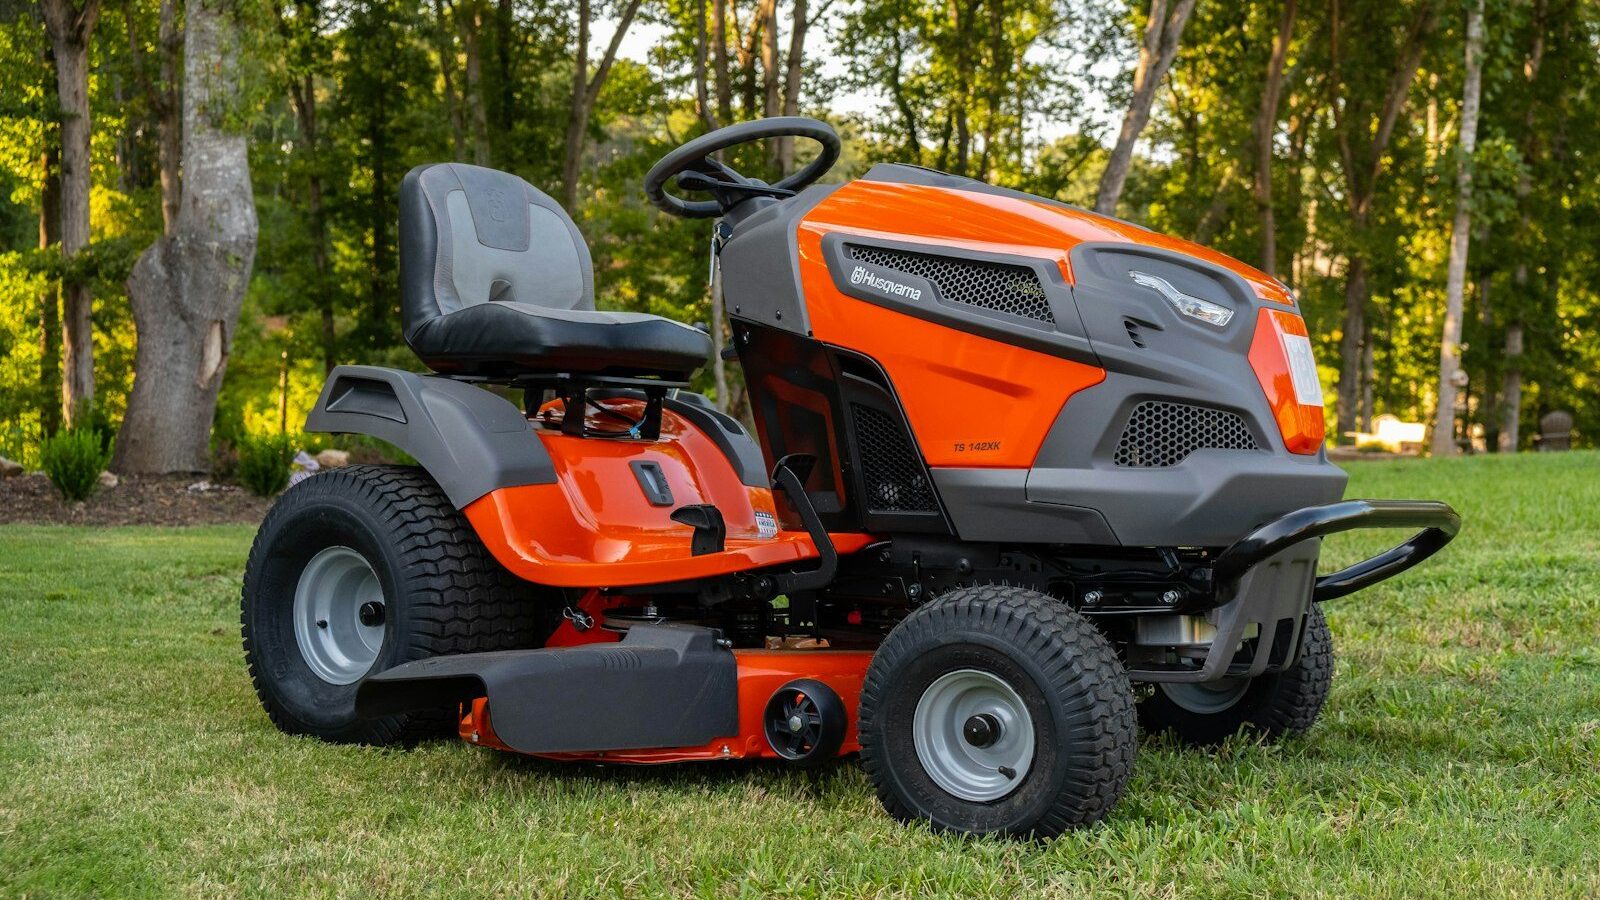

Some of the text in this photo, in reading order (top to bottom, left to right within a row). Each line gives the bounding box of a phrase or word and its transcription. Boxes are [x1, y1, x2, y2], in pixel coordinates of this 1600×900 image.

[862, 271, 921, 300] Husqvarna
[953, 441, 1001, 452] TS 142XK
